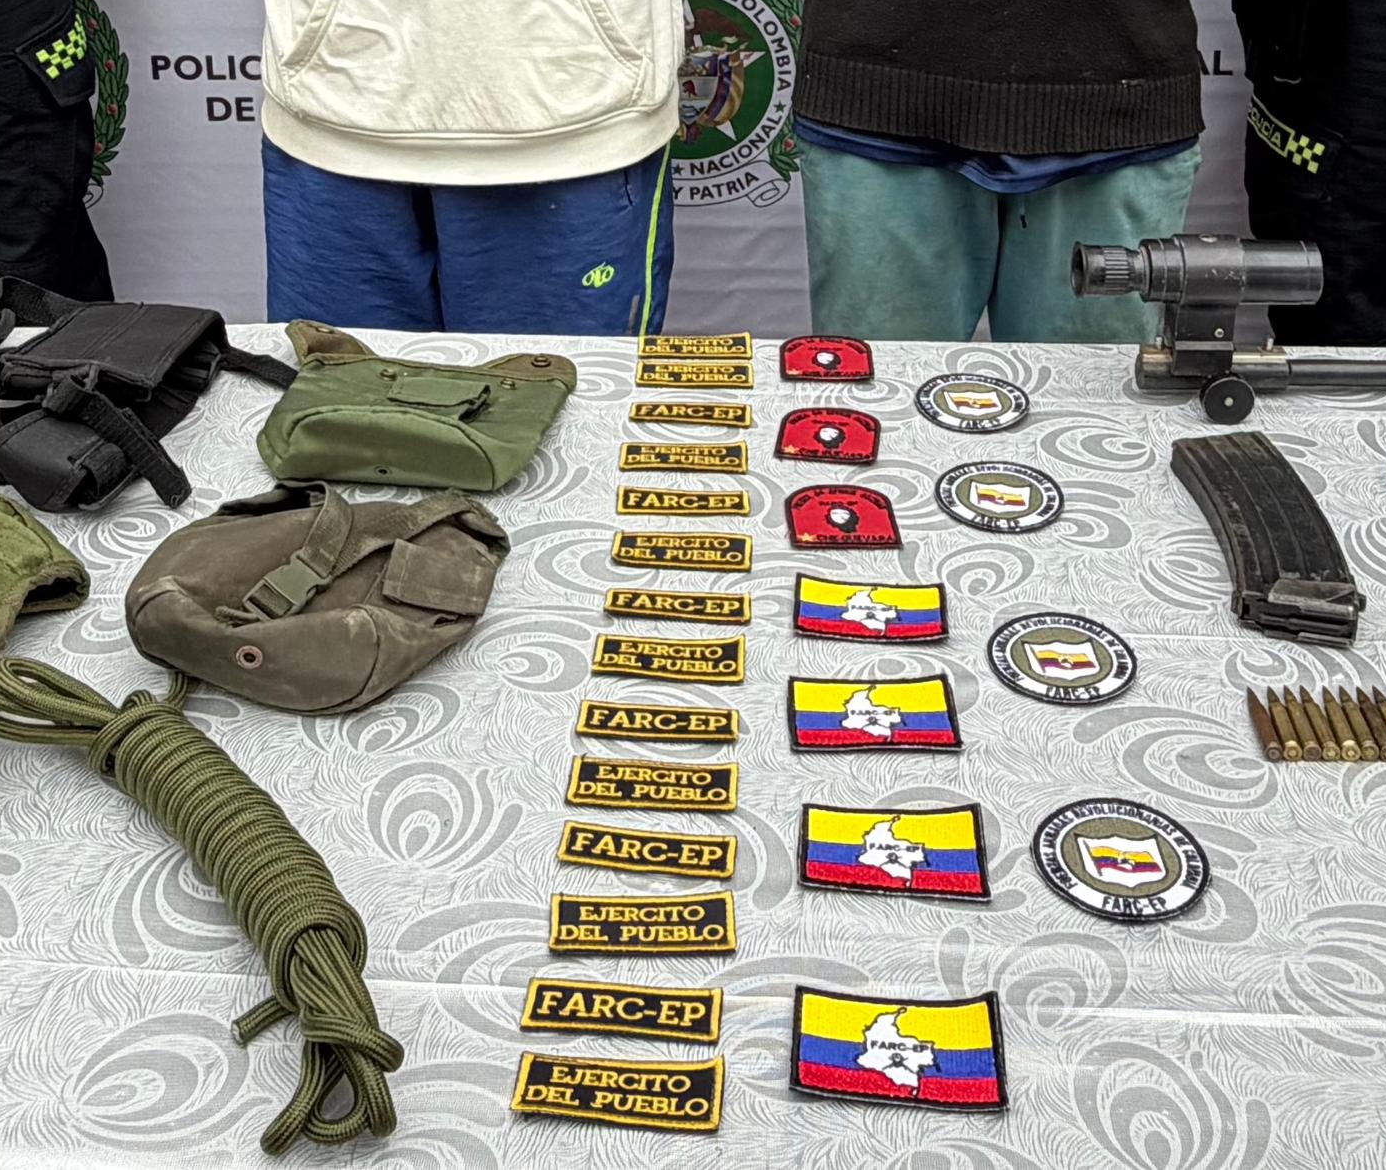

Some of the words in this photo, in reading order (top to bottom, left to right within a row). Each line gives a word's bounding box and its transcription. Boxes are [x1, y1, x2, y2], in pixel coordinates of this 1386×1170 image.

[206, 97, 255, 121] DE
[690, 115, 782, 176] NACIONAL
[690, 171, 760, 200] PATRIA
[638, 405, 741, 419] FARC-EP
[627, 493, 740, 509] FARC-EP
[635, 536, 729, 549] EJERCITO
[620, 547, 656, 559] DEL
[664, 549, 742, 562] PUEBLO
[616, 593, 740, 614] FARC-EP
[619, 642, 723, 658] EJERCITO
[602, 653, 641, 667] DEL
[651, 658, 737, 673] PUEBLO
[589, 709, 728, 730] FARC-EP
[596, 765, 711, 785] EJERCITO
[578, 781, 622, 797] DEL
[631, 784, 727, 801] PUEBLO
[572, 831, 723, 866] FARC-EP
[579, 905, 705, 922] EJERCITO
[1102, 896, 1167, 914] FARC-EP
[559, 924, 608, 942] DEL
[620, 924, 724, 942] PUEBLO
[537, 991, 706, 1026] FARC-EP
[870, 1041, 927, 1053] FARC-EP
[550, 1065, 692, 1093] EJERCITO
[526, 1085, 579, 1106] DEL
[590, 1091, 709, 1116] PUEBLO
